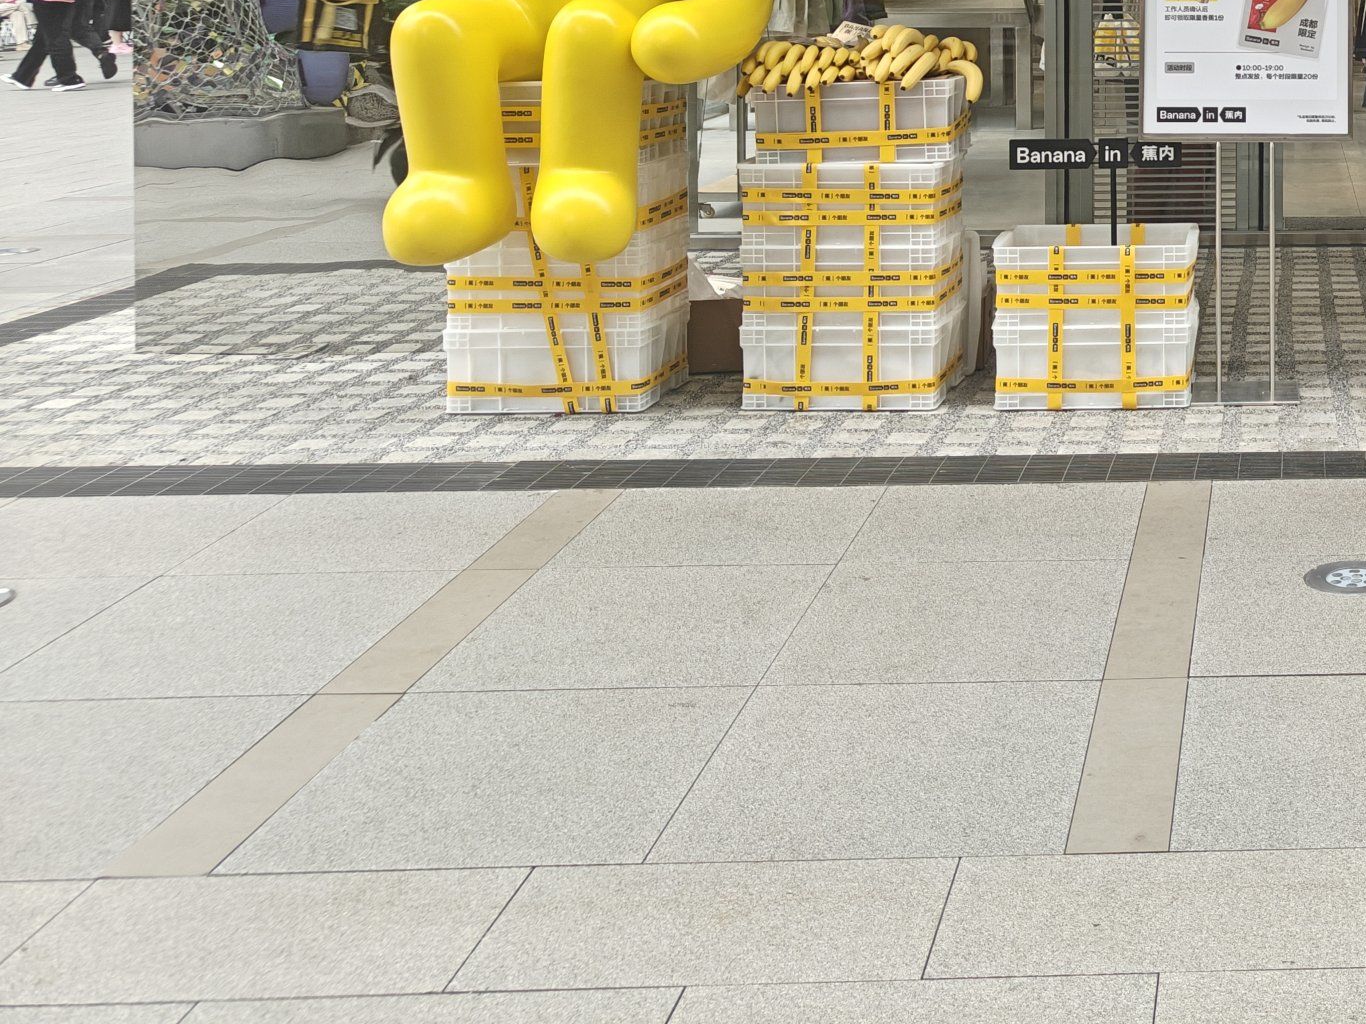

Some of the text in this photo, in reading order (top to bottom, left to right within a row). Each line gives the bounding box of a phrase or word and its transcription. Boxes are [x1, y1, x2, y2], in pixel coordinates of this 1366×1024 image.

[1159, 110, 1196, 120] Banana
[1206, 110, 1215, 120] in
[1016, 145, 1175, 164] Banana in 蕉内
